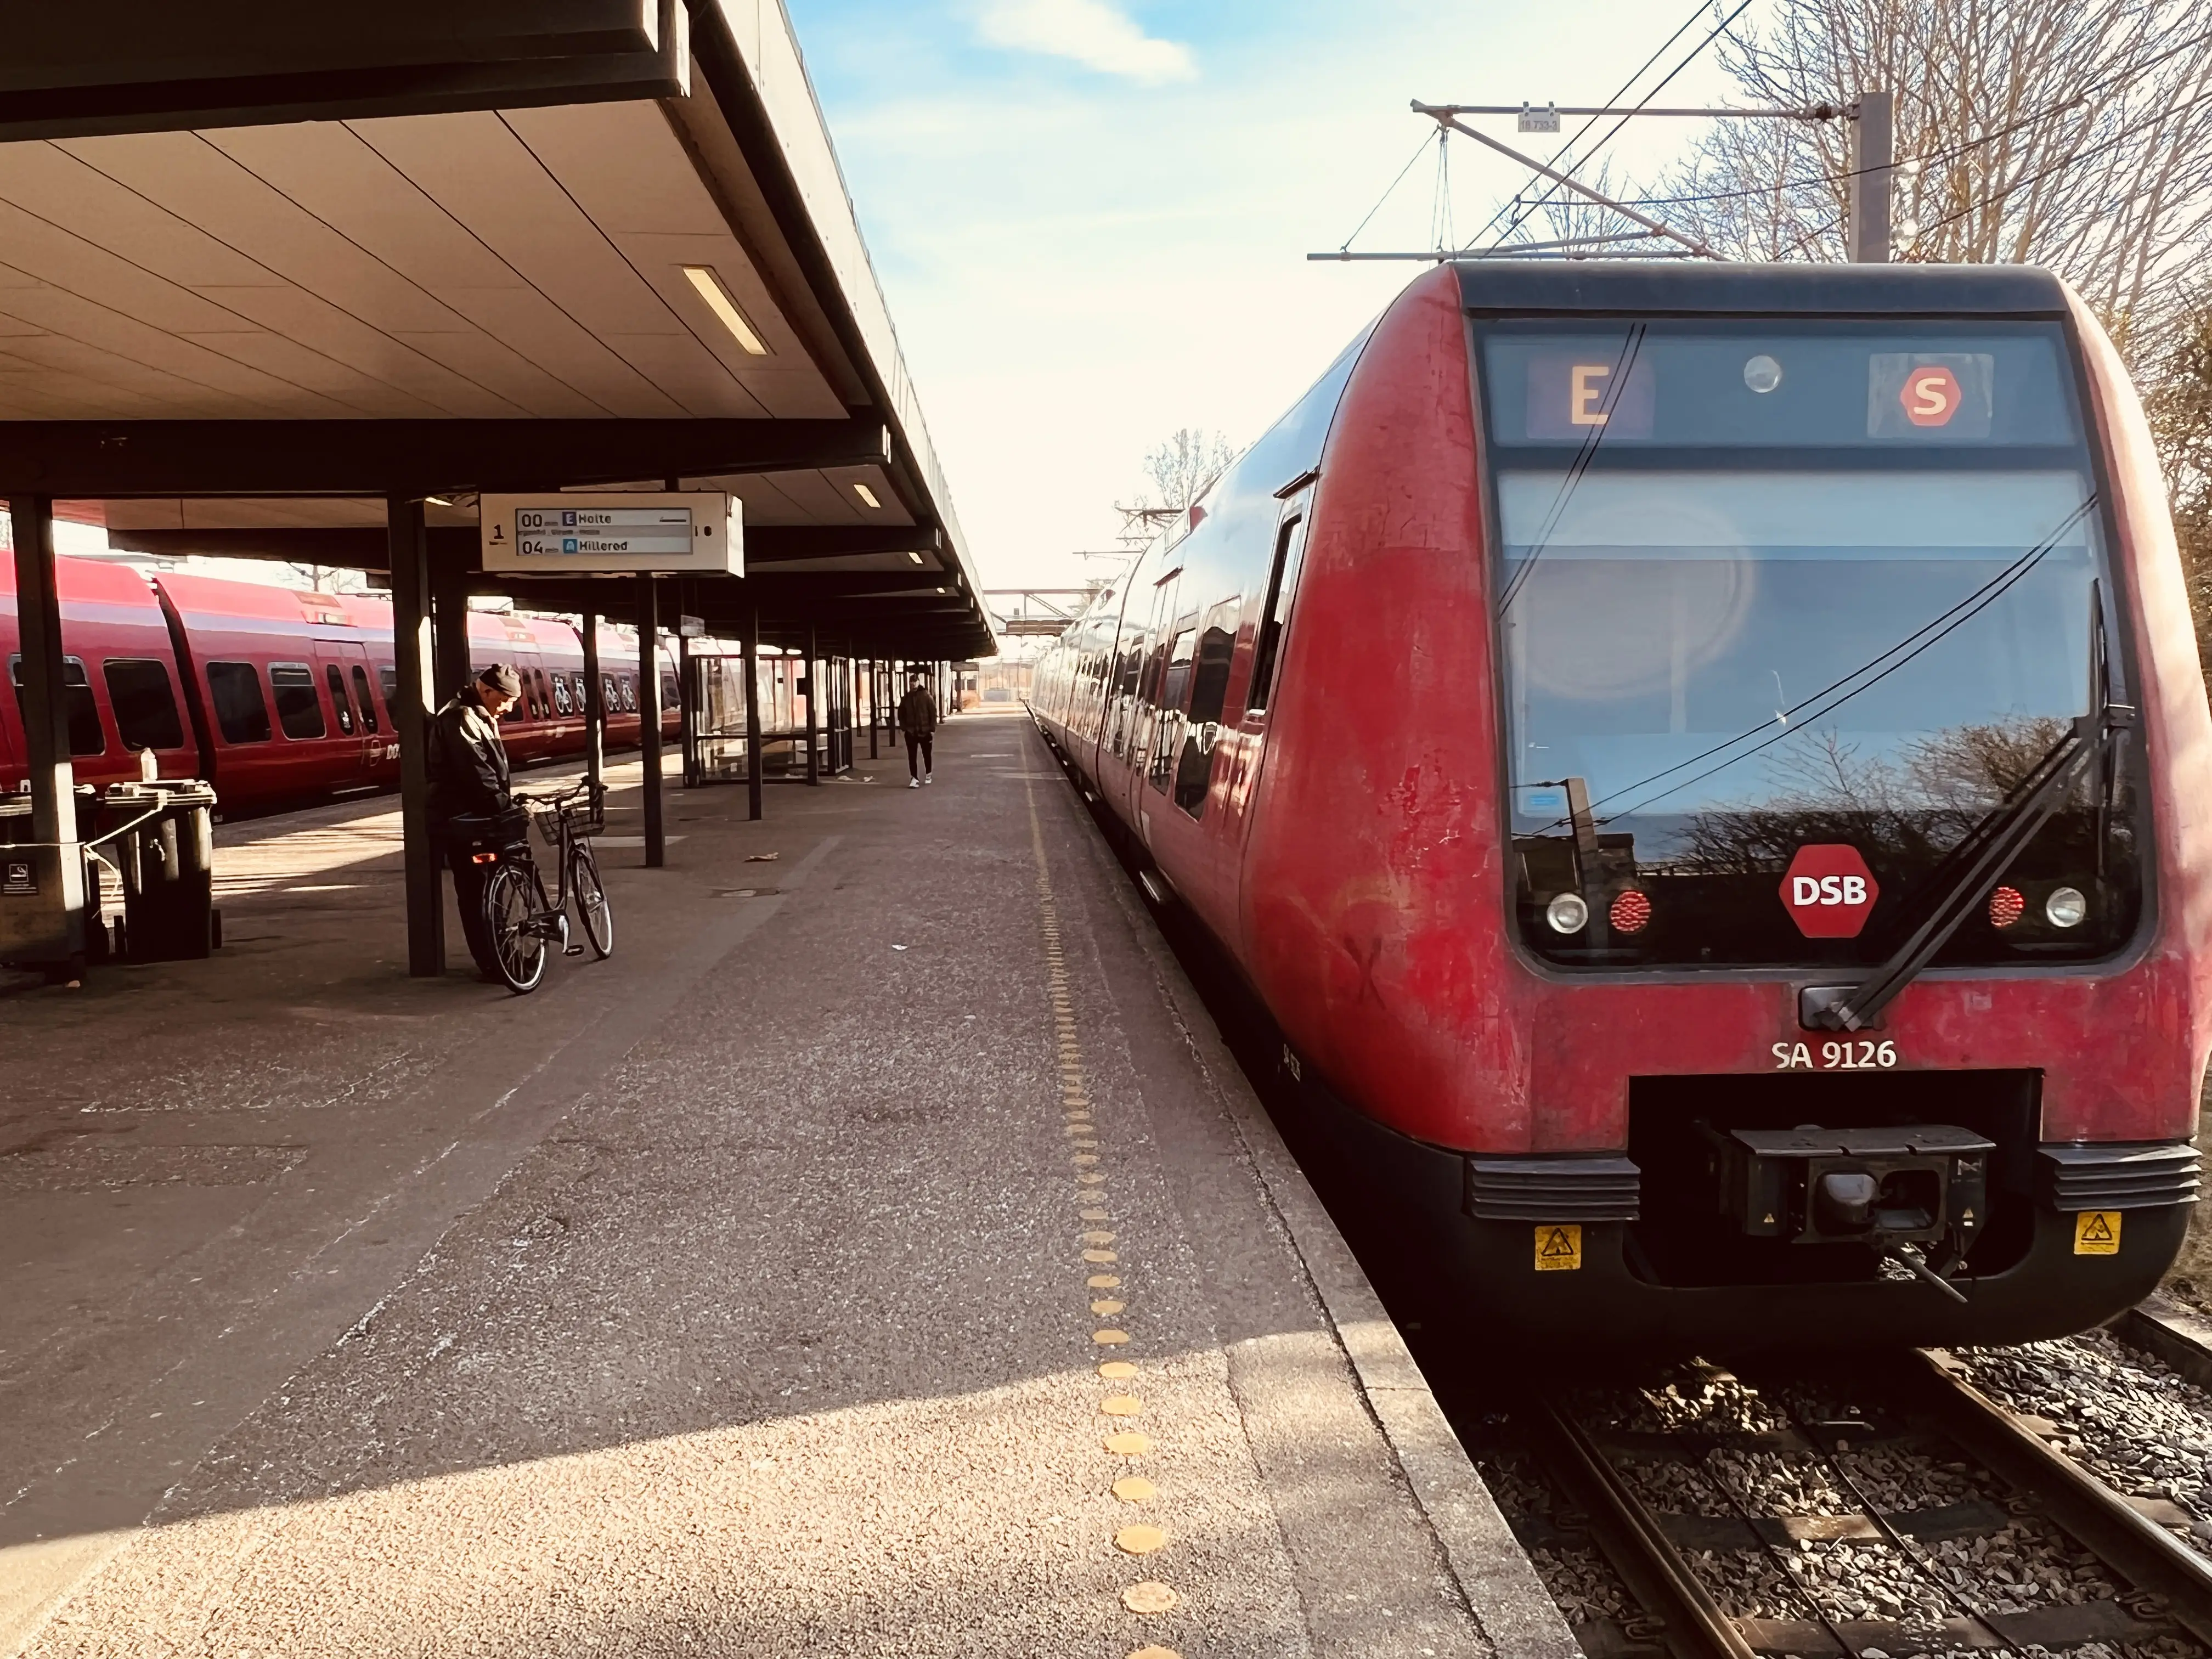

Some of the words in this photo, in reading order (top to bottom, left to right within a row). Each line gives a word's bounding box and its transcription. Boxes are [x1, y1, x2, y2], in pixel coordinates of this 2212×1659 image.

[1572, 366, 1609, 425] E
[1914, 377, 1947, 415] S
[493, 524, 504, 539] 1
[522, 514, 542, 527] 00
[566, 513, 574, 524] E
[579, 514, 611, 524] Holte
[522, 541, 543, 554] 04
[1793, 876, 1867, 906] DSB
[1771, 1041, 1813, 1069] SA
[1822, 1040, 1897, 1068] 9126
